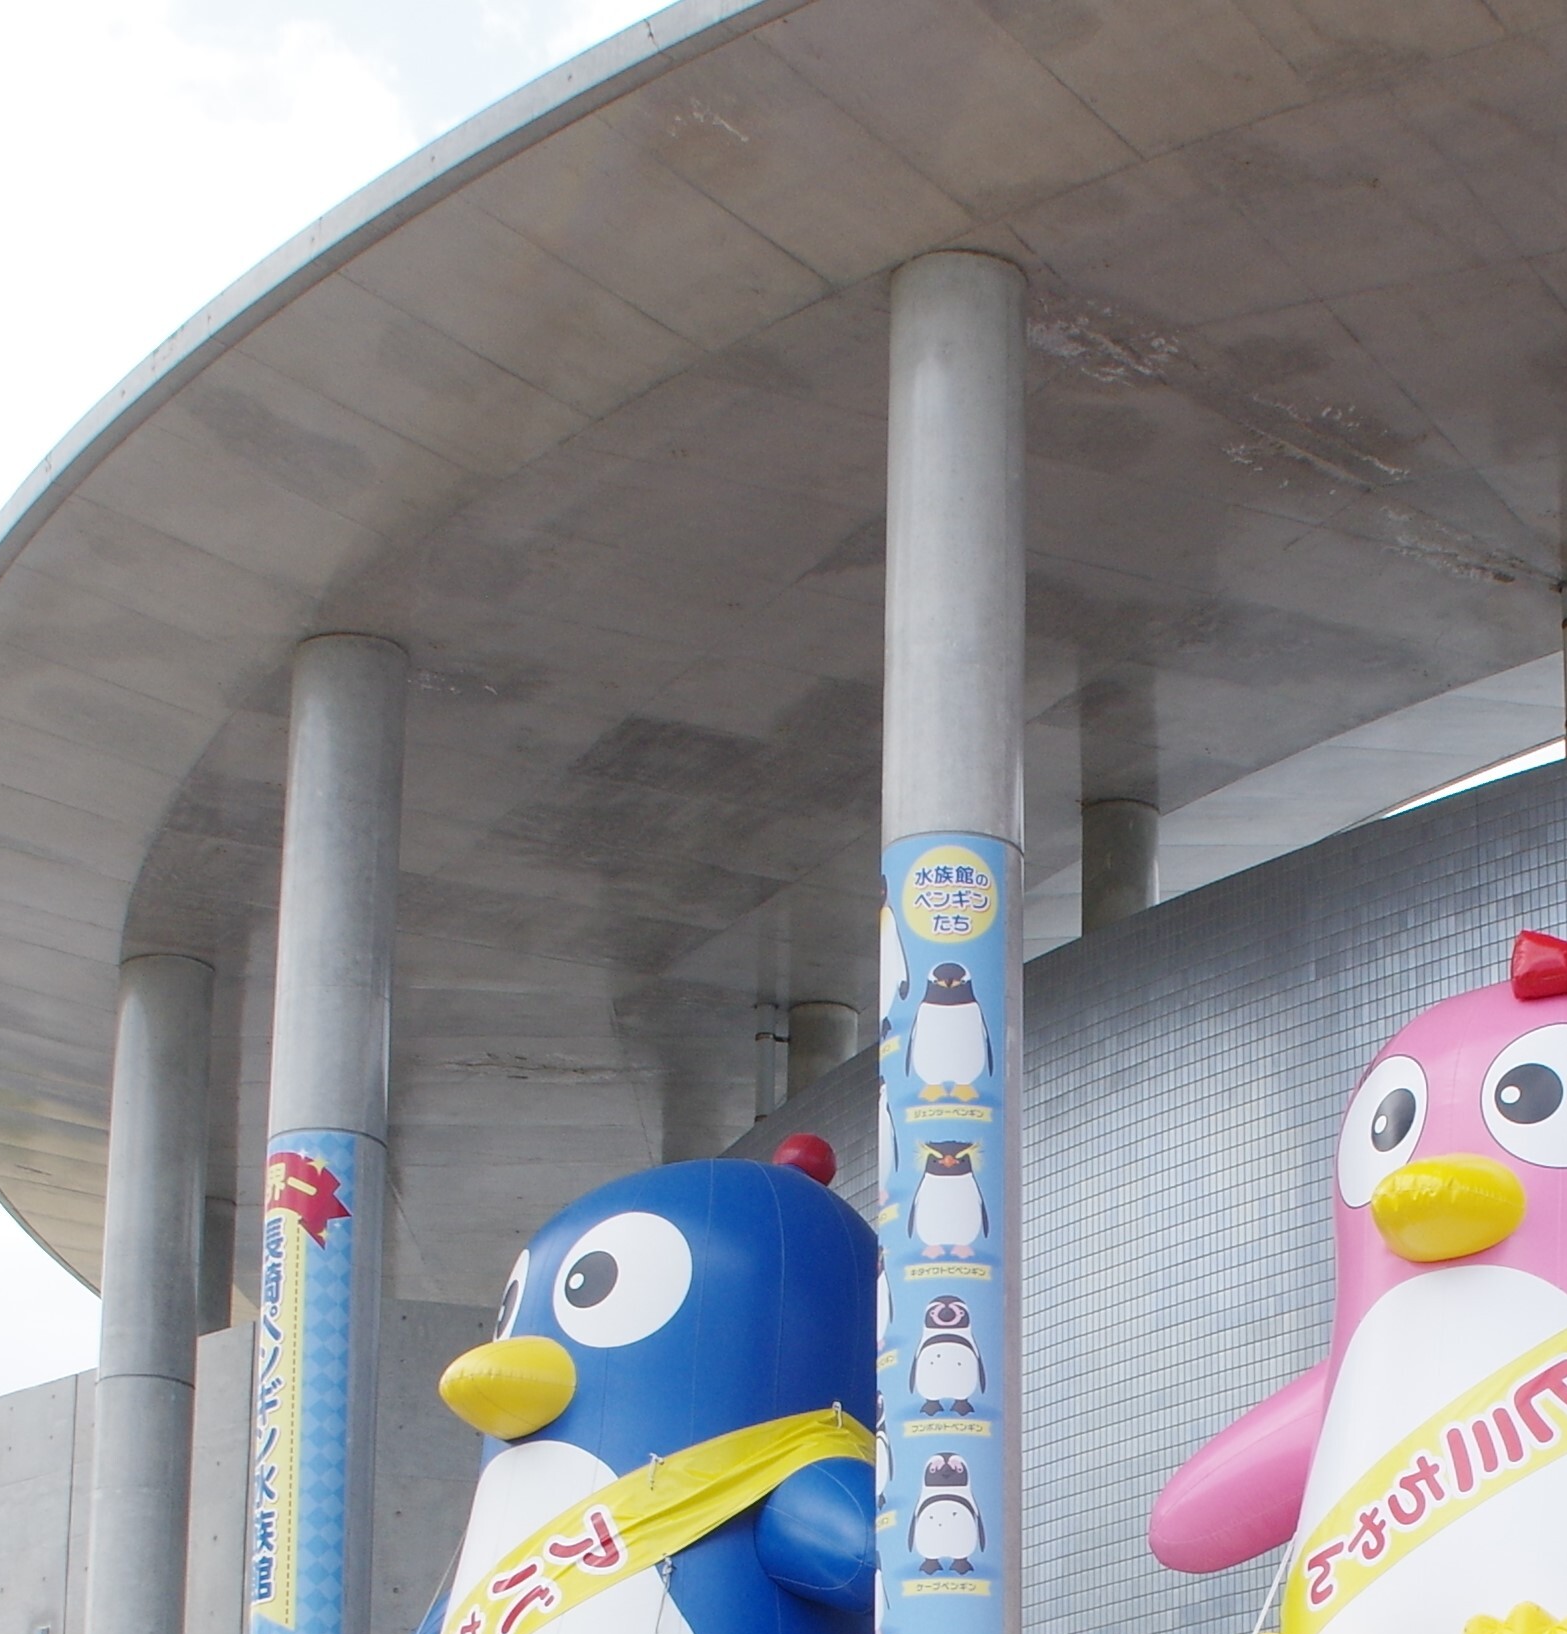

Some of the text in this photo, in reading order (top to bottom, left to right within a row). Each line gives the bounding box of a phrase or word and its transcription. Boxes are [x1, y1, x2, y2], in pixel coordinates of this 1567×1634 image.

[914, 865, 990, 888] 水族館の
[913, 889, 990, 909] ペンギン
[932, 914, 972, 933] たち
[913, 1107, 985, 1118] ジェンツーペンギン
[910, 1265, 986, 1277] キタイワトビペンギン
[910, 1422, 983, 1433] フンボルトペンギン
